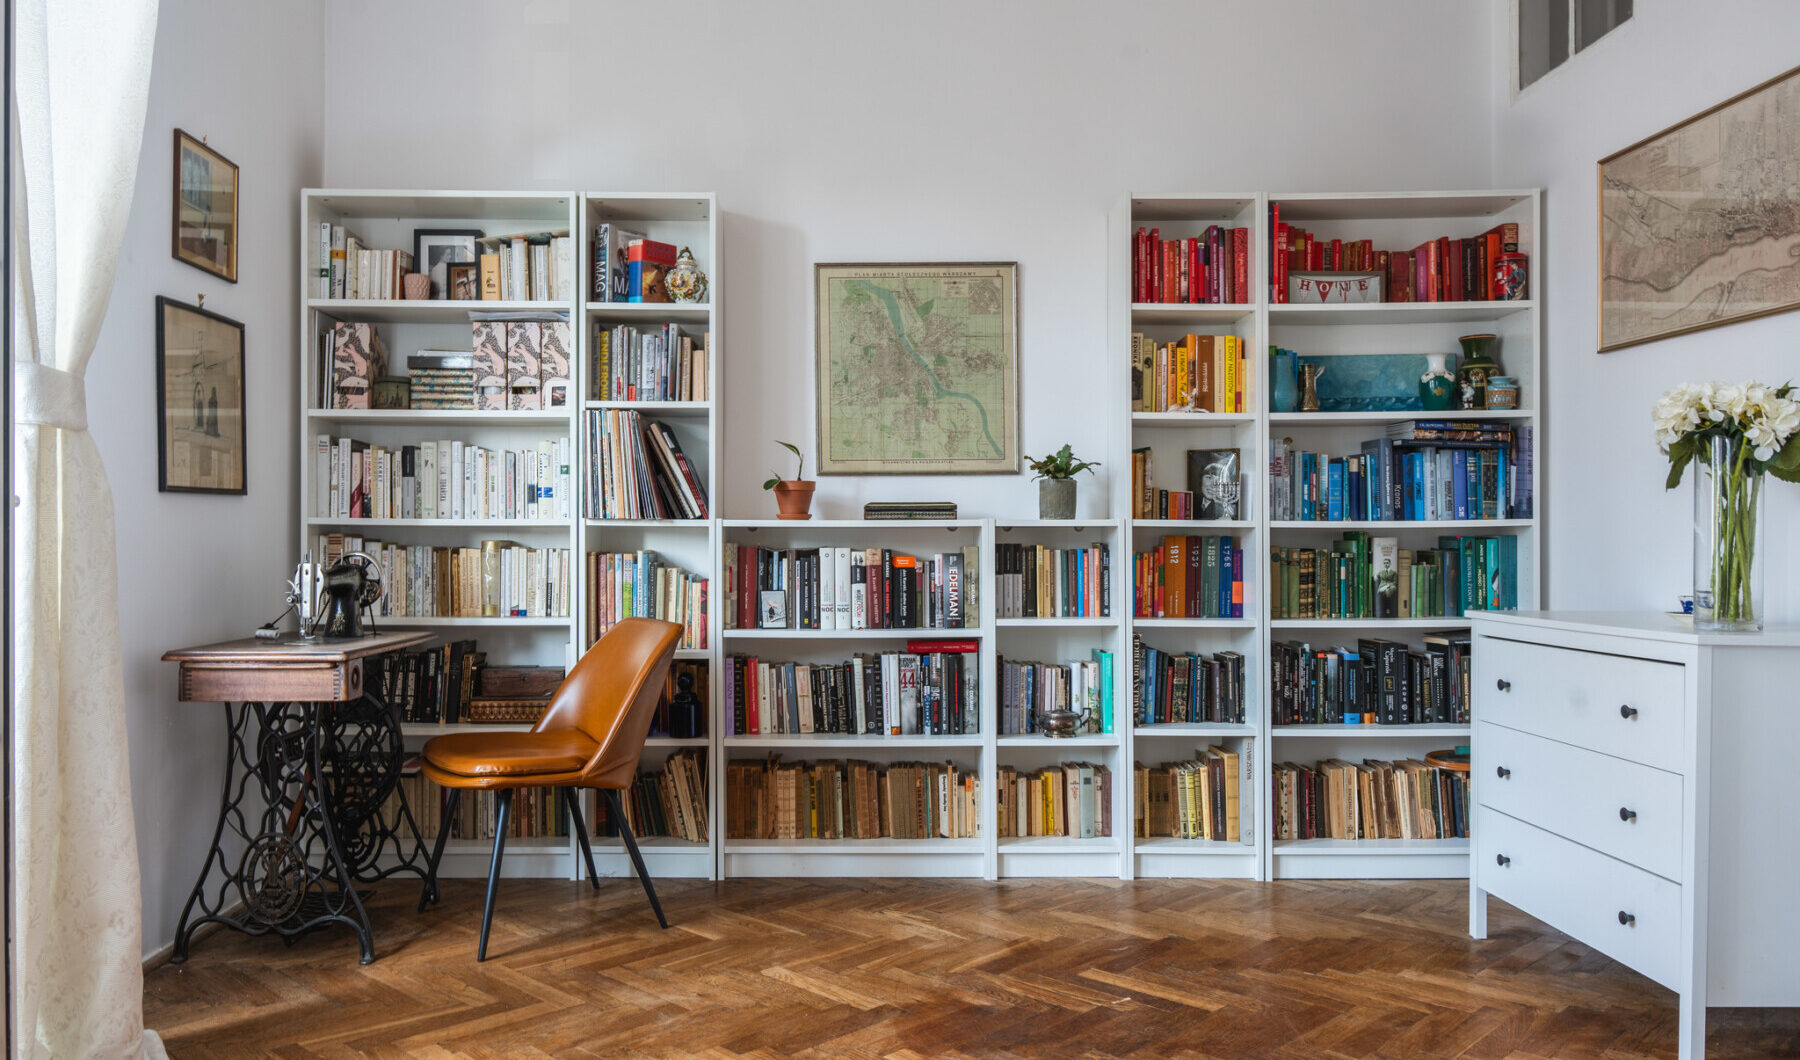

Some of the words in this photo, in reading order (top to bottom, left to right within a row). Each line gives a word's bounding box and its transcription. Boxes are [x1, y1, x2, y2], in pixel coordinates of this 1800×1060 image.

[1300, 280, 1368, 293] HOME
[1170, 545, 1179, 564] 1812
[1191, 545, 1199, 568] 1939
[1207, 545, 1216, 567] 1825
[949, 566, 958, 616] EDELMAN
[931, 686, 940, 700] 1945
